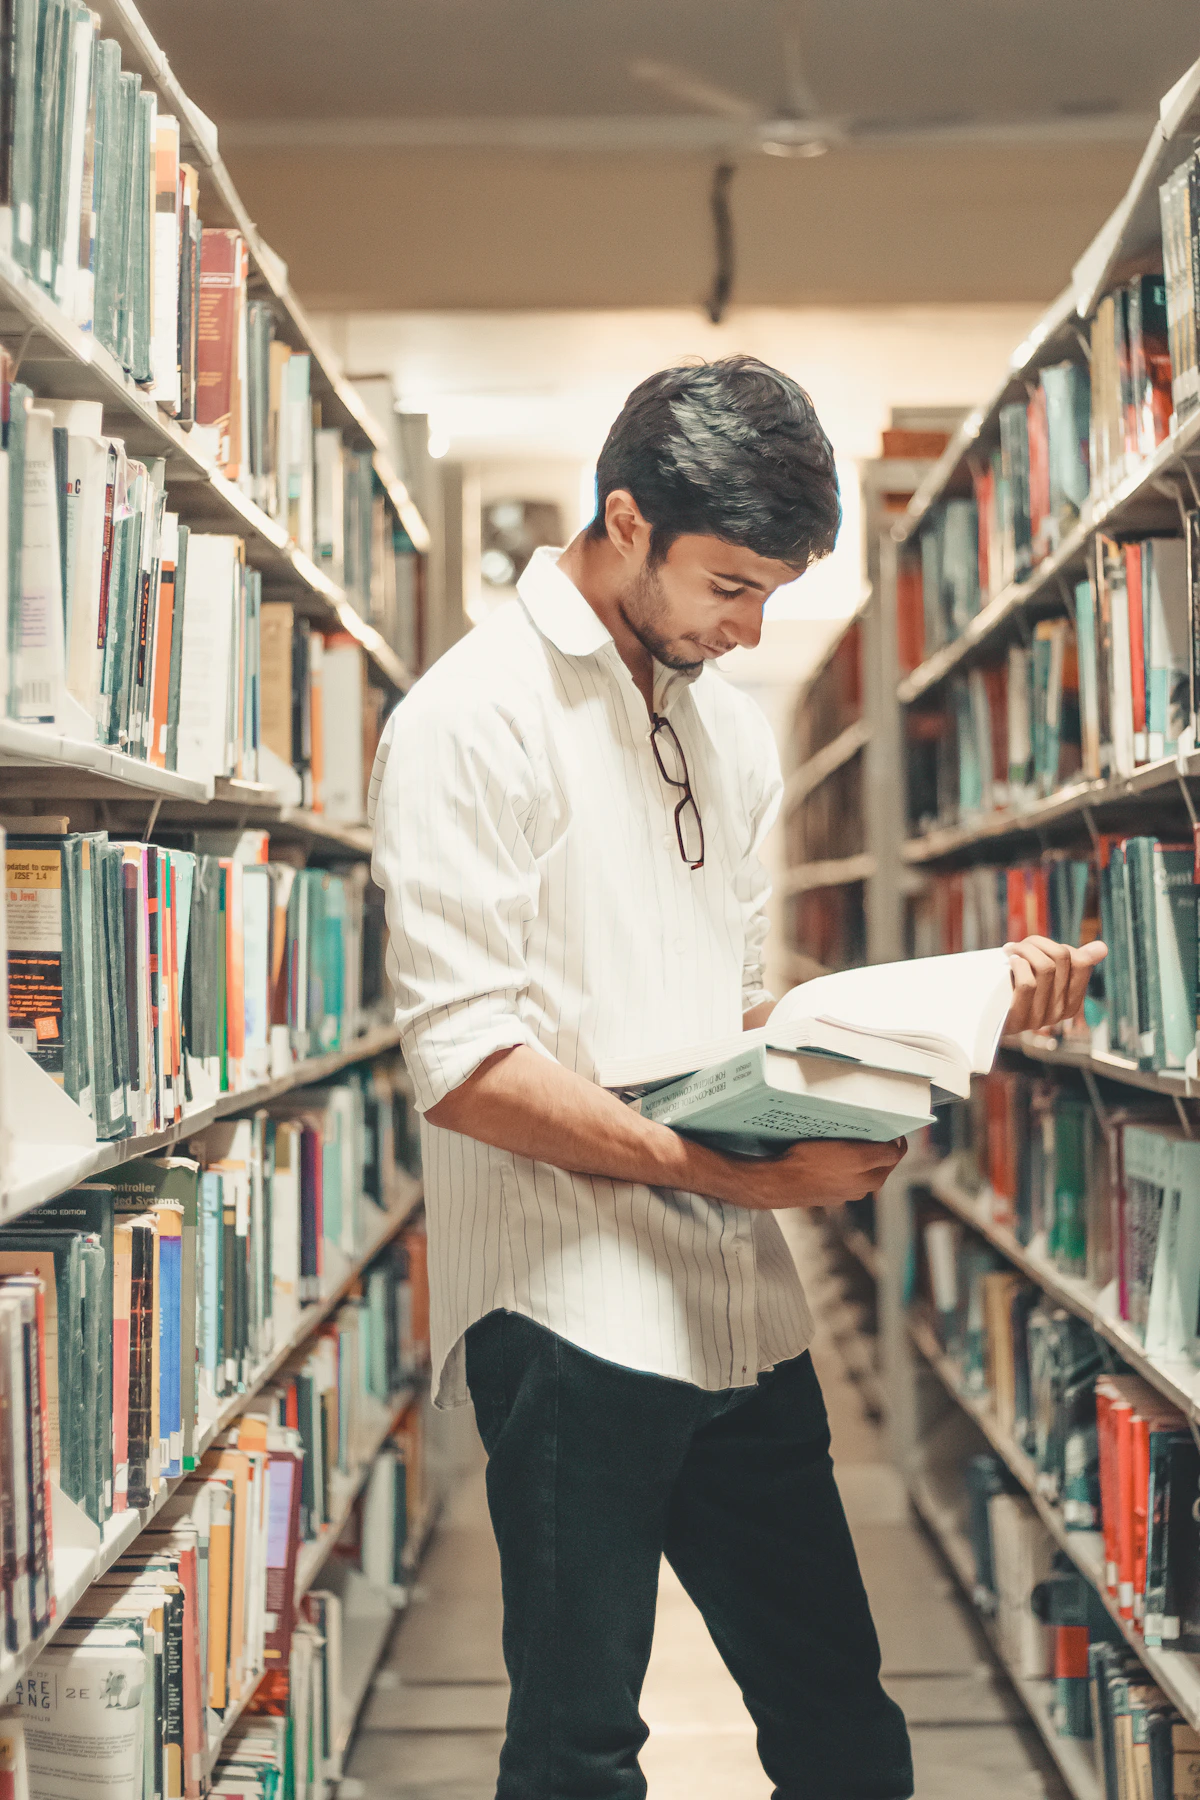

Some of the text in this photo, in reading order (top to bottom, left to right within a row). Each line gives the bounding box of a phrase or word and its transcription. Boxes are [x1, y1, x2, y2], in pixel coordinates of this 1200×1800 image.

[32, 863, 39, 871] to
[715, 1070, 726, 1082] FOR
[65, 1688, 90, 1700] 2E
